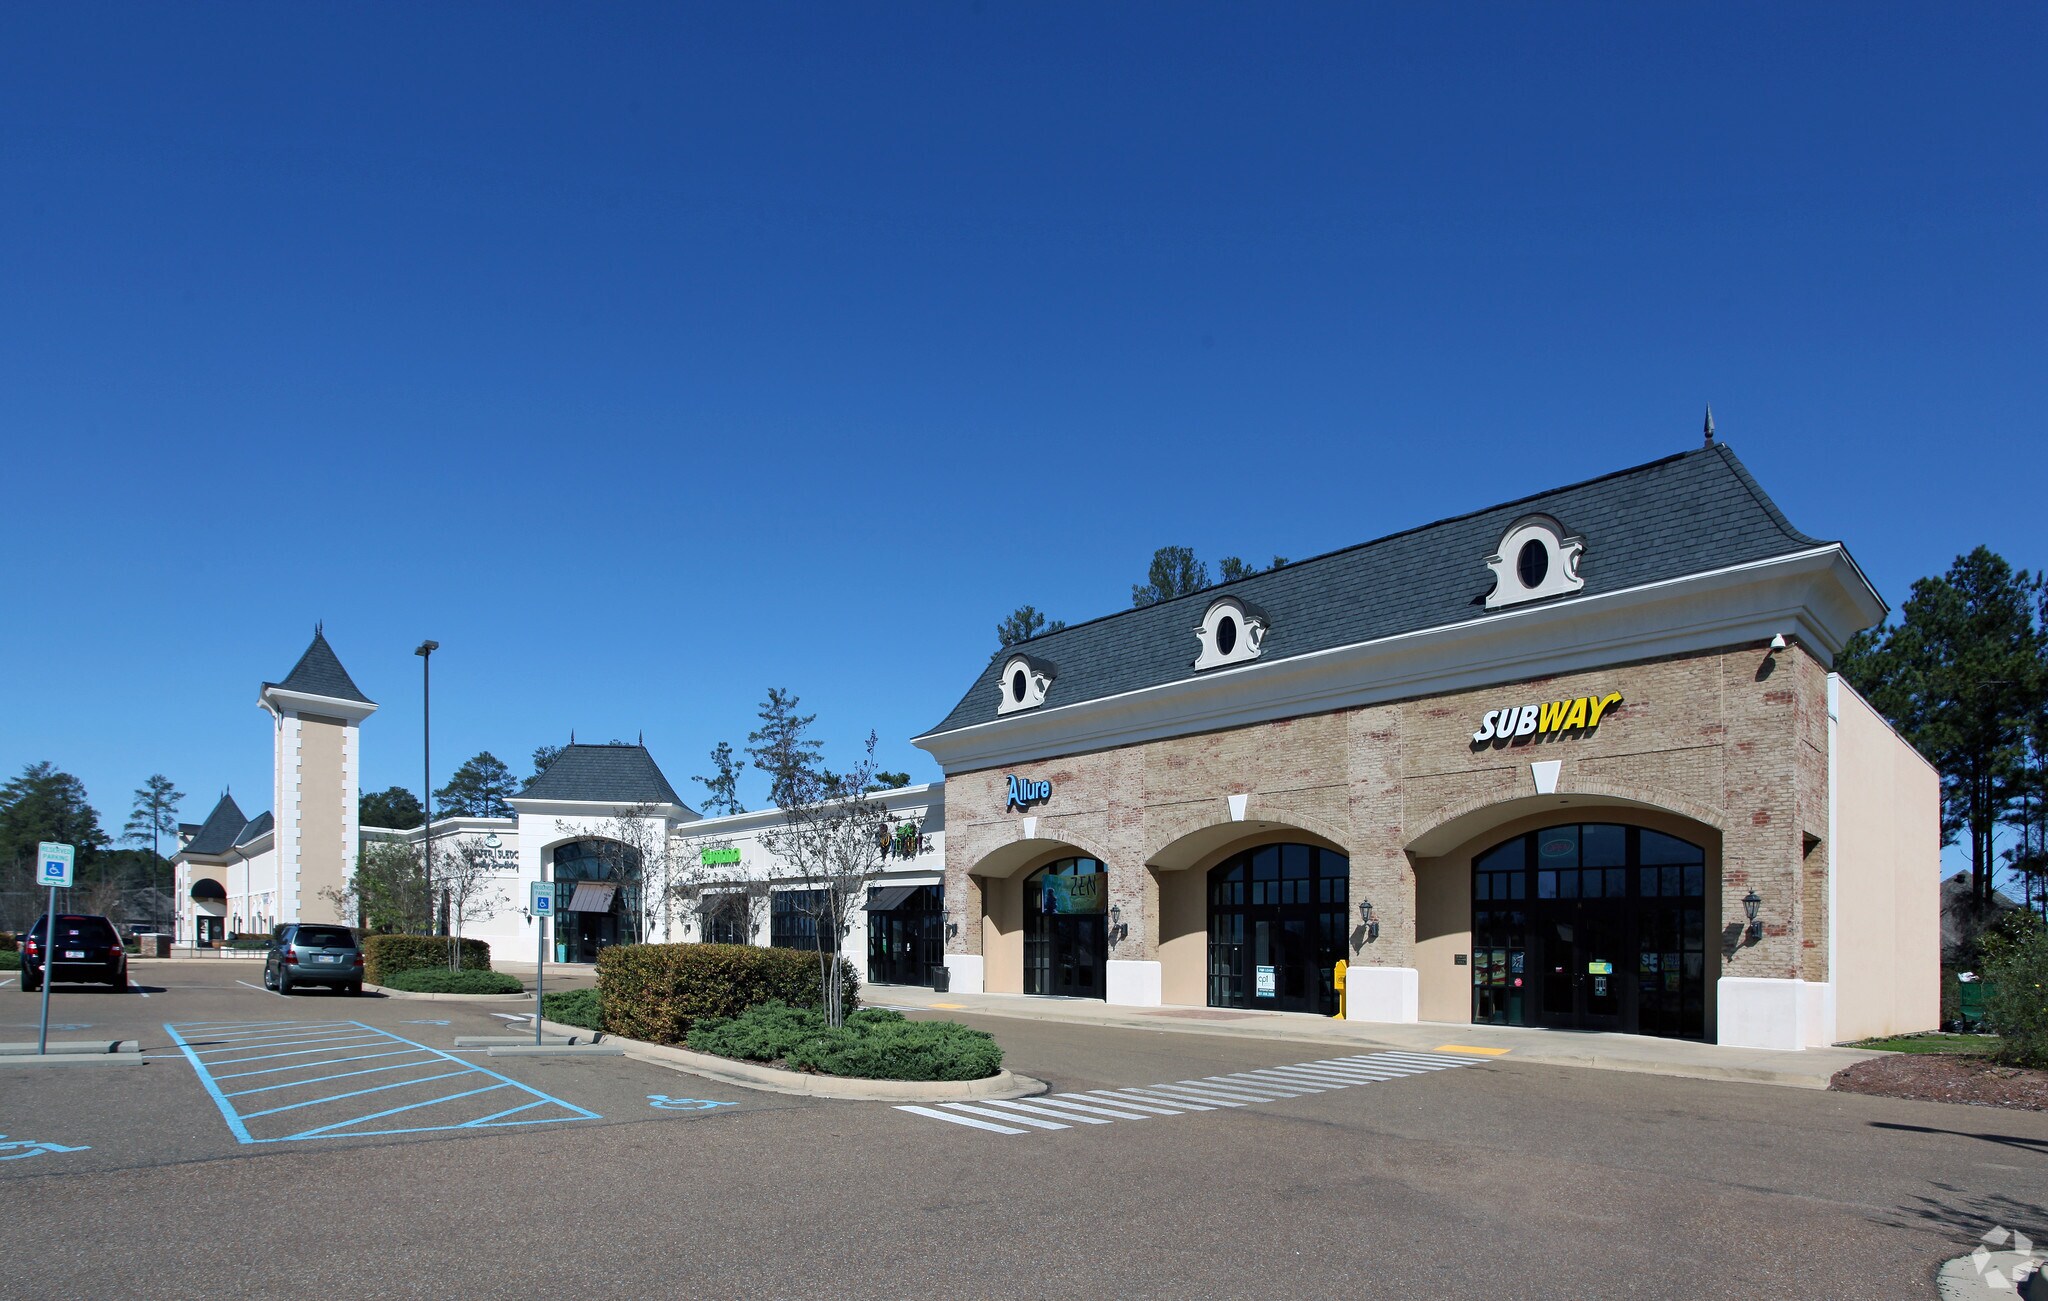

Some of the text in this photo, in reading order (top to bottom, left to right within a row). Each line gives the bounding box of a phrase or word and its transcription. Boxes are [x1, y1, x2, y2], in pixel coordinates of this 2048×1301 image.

[1472, 690, 1623, 743] SUBWAY
[1007, 774, 1050, 806] Allure
[41, 845, 71, 855] RESERVED
[43, 853, 69, 861] PARKING
[1070, 875, 1097, 896] ZEN
